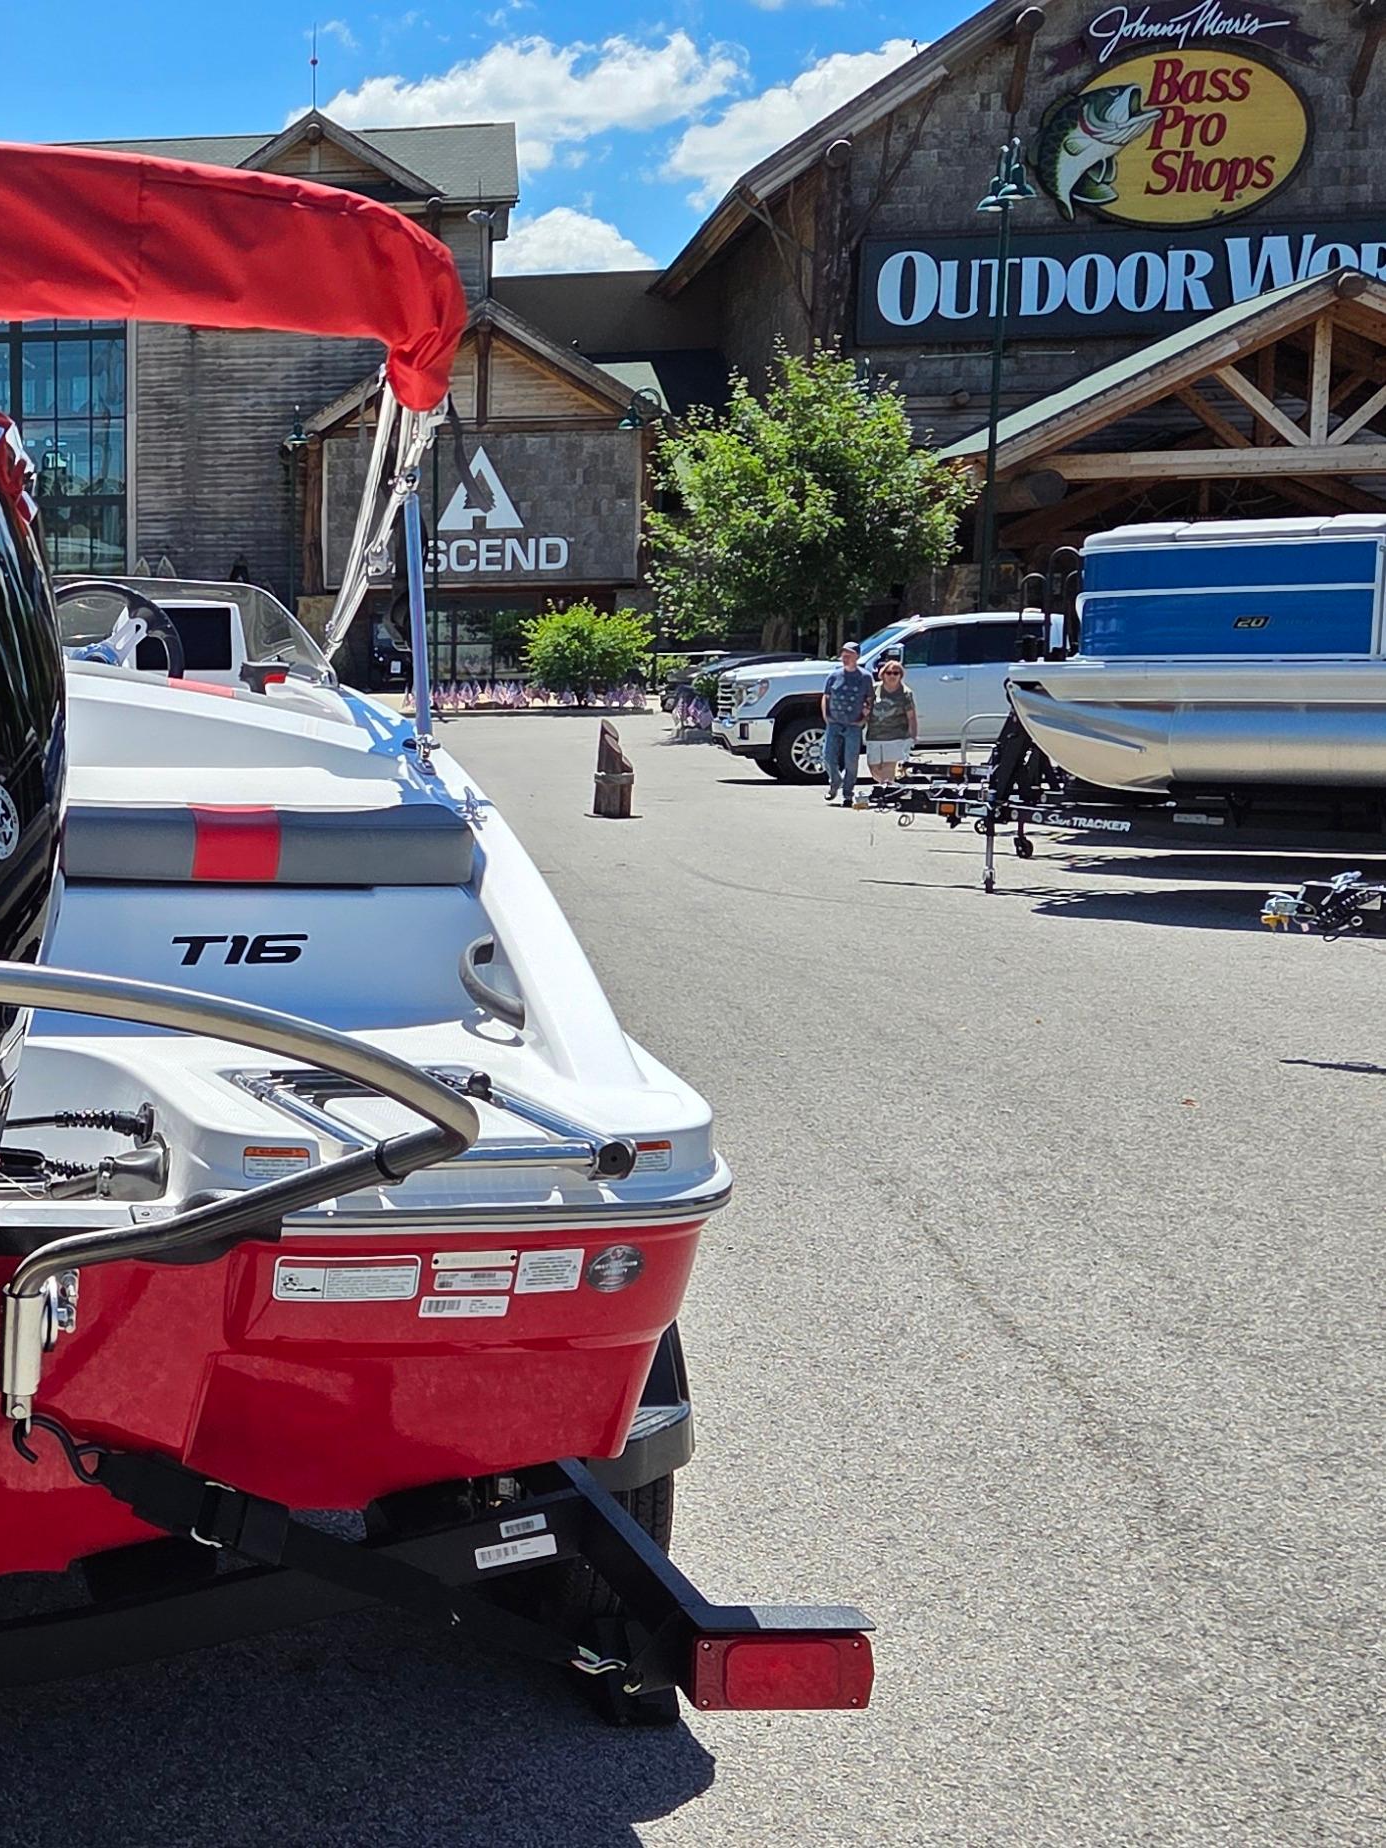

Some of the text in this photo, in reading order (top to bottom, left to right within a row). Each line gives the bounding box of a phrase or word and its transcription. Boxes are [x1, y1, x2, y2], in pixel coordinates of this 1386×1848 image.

[1089, 0, 1291, 62] Johnny Morris
[1143, 58, 1253, 106] Bass
[1146, 105, 1227, 150] Pro
[1144, 149, 1276, 202] Shops
[877, 249, 1213, 326] OUTDOOR
[397, 536, 569, 573] SCEND
[1236, 617, 1266, 629] 20
[1071, 816, 1131, 832] TRACKER
[171, 933, 308, 966] T16
